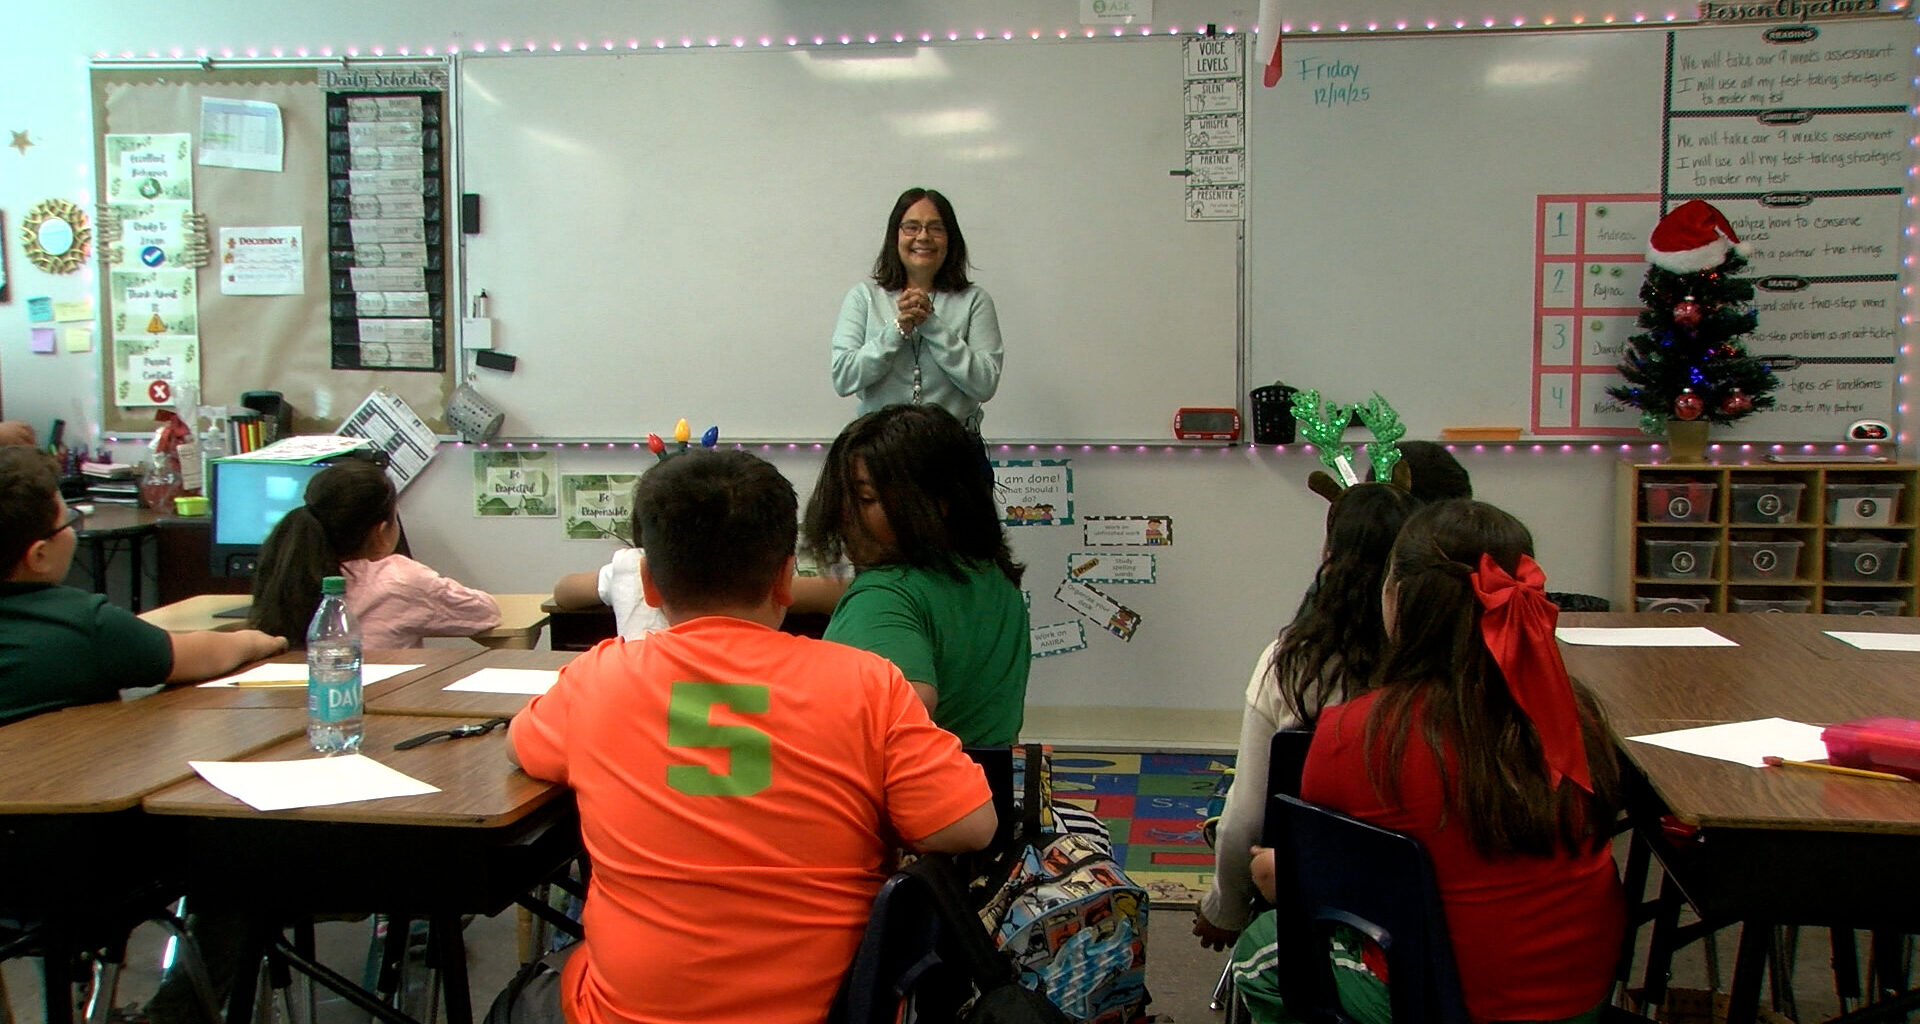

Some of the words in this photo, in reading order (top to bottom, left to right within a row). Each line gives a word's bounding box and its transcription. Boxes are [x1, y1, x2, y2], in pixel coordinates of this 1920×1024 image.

[1705, 2, 1772, 20] Lesson
[1769, 30, 1812, 40] READING
[1199, 42, 1226, 55] VOICE
[1680, 55, 1697, 70] We
[1702, 50, 1721, 68] will
[1726, 52, 1752, 68] take
[1757, 55, 1774, 66] our
[1779, 50, 1786, 63] 9
[1789, 48, 1821, 64] weeks
[1825, 44, 1895, 62] assessment
[1197, 58, 1228, 73] LEVELS
[1295, 57, 1360, 81] Friday
[326, 70, 368, 89] Daily
[1718, 78, 1738, 90] use
[1758, 77, 1774, 90] my
[1202, 84, 1225, 94] SILENT
[1313, 86, 1370, 108] 12/19/25
[1702, 93, 1713, 105] to
[1750, 94, 1765, 105] my
[1199, 119, 1229, 129] WHISPER
[1677, 133, 1693, 147] We
[1698, 132, 1717, 146] will
[1723, 133, 1748, 145] take
[1752, 134, 1771, 144] our
[1777, 129, 1787, 143] 9
[1792, 130, 1828, 143] weeks
[1833, 129, 1893, 142] assessment
[1200, 155, 1230, 165] PARTNER
[1677, 156, 1691, 169] I
[1692, 154, 1711, 168] will
[1715, 158, 1732, 167] use
[1739, 152, 1754, 166] all
[1759, 154, 1777, 167] my
[1845, 150, 1902, 166] strategies
[1693, 173, 1707, 186] to
[1709, 174, 1741, 185] master
[1745, 174, 1762, 186] my
[1766, 172, 1790, 184] test
[1197, 190, 1233, 201] PRESENTER
[1764, 196, 1806, 204] SCIENCE
[1551, 212, 1568, 238] 1
[1731, 217, 1766, 233] nalyze
[1796, 215, 1809, 228] to
[239, 237, 284, 246] December
[1779, 249, 1816, 261] partner
[1552, 268, 1564, 294] 2
[1767, 280, 1799, 288] MATH
[128, 289, 151, 299] Think
[154, 289, 177, 299] About
[1552, 323, 1566, 350] 3
[1790, 330, 1825, 341] problem
[142, 370, 173, 380] Contact
[1790, 378, 1815, 392] types
[1818, 379, 1833, 390] of
[1837, 378, 1883, 389] landforms
[1552, 386, 1563, 409] 4
[509, 469, 520, 479] Be
[1005, 476, 1024, 484] am
[1027, 474, 1060, 484] done!
[495, 483, 536, 495] Respectful
[1024, 486, 1053, 494] Should
[598, 493, 609, 503] Be
[1022, 495, 1037, 504] do?
[581, 506, 628, 518] Responsible
[1112, 564, 1136, 572] spelling
[1115, 558, 1133, 566] Study
[1034, 631, 1056, 642] Work
[328, 680, 359, 711] DAS
[666, 681, 772, 797] 5
